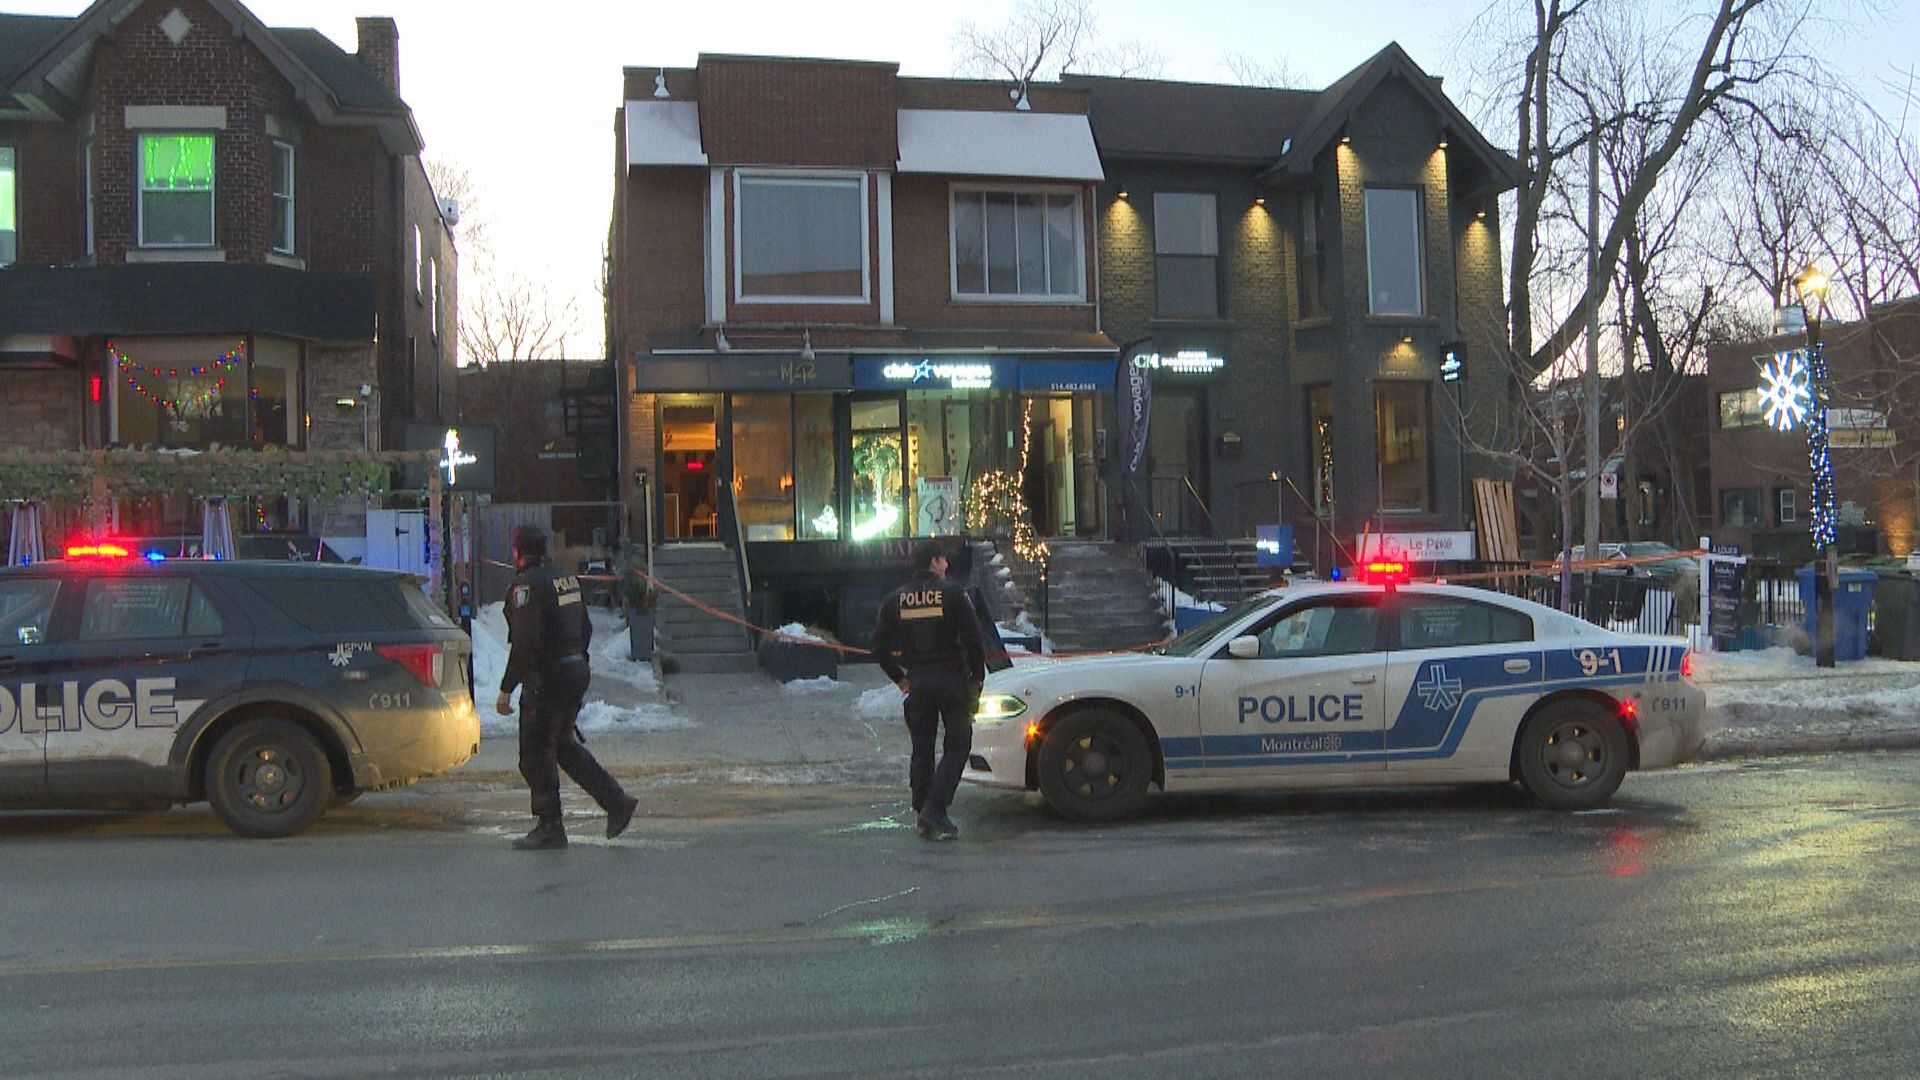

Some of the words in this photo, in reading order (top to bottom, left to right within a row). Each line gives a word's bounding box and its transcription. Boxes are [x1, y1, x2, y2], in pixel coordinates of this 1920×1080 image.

[1128, 360, 1143, 422] voyages
[1409, 538, 1423, 551] Le
[900, 591, 942, 606] POLICE
[344, 642, 372, 652] SPVM
[1579, 648, 1622, 677] 9-1
[1175, 685, 1196, 698] 9-1
[380, 693, 411, 708] 911
[1662, 697, 1686, 712] 911
[1238, 694, 1364, 724] POLICE
[1261, 735, 1323, 752] Montréal
